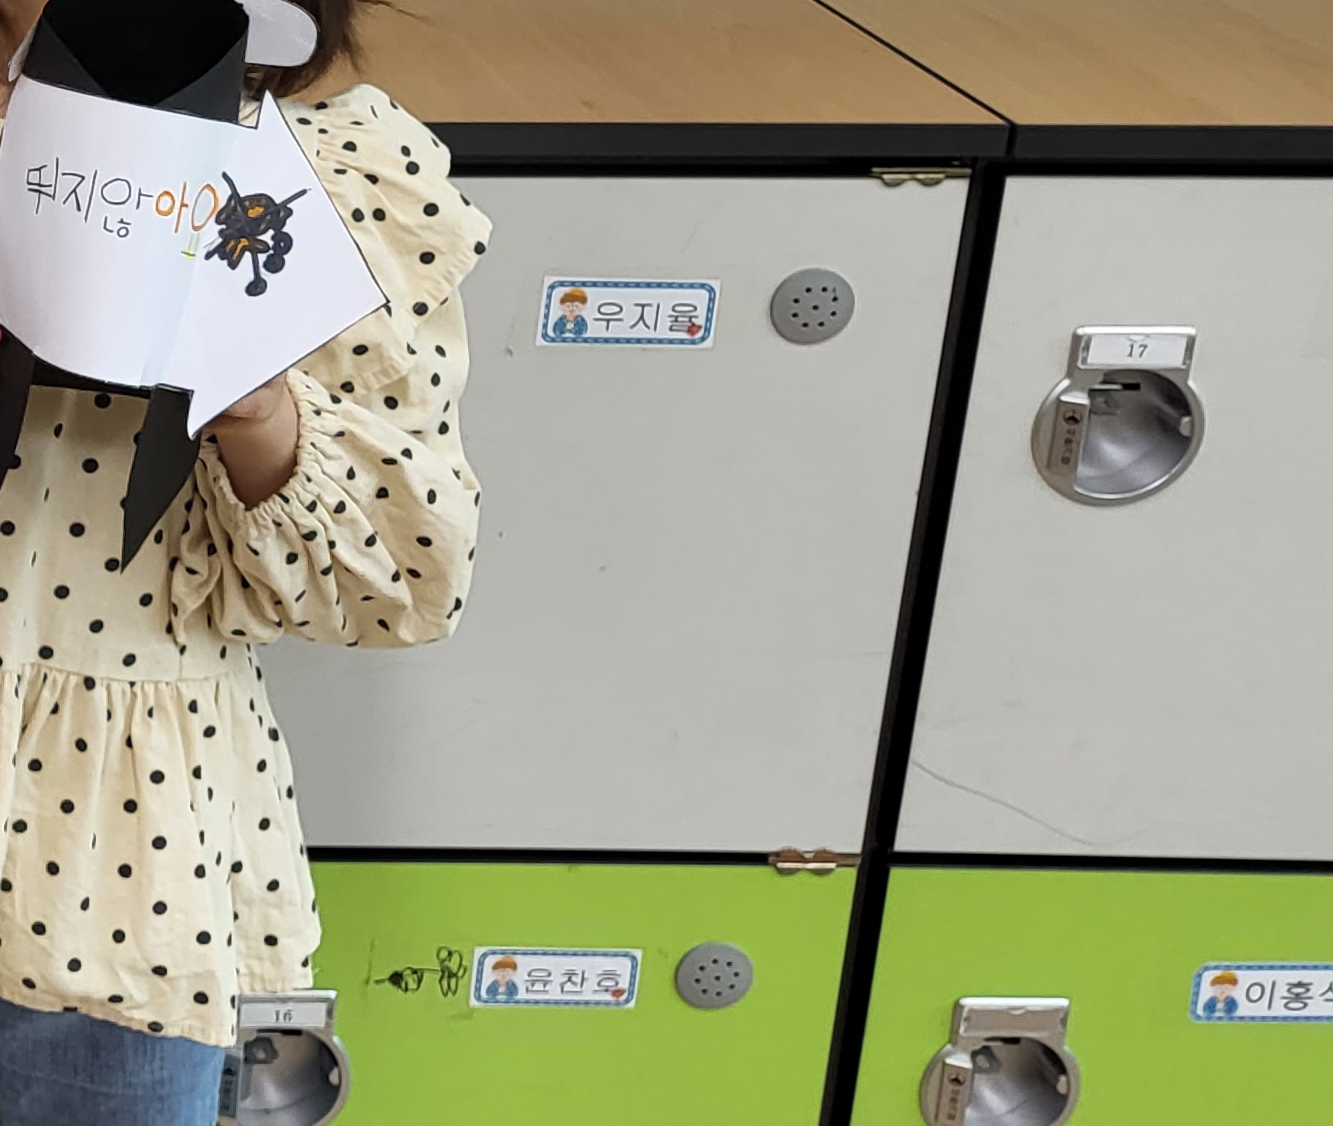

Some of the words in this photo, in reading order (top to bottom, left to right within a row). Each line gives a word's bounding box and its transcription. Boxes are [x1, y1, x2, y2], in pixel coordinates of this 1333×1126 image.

[590, 301, 699, 334] 우지율
[1127, 343, 1149, 359] 17
[524, 968, 621, 995] 윤찬호
[275, 1009, 294, 1023] 16
